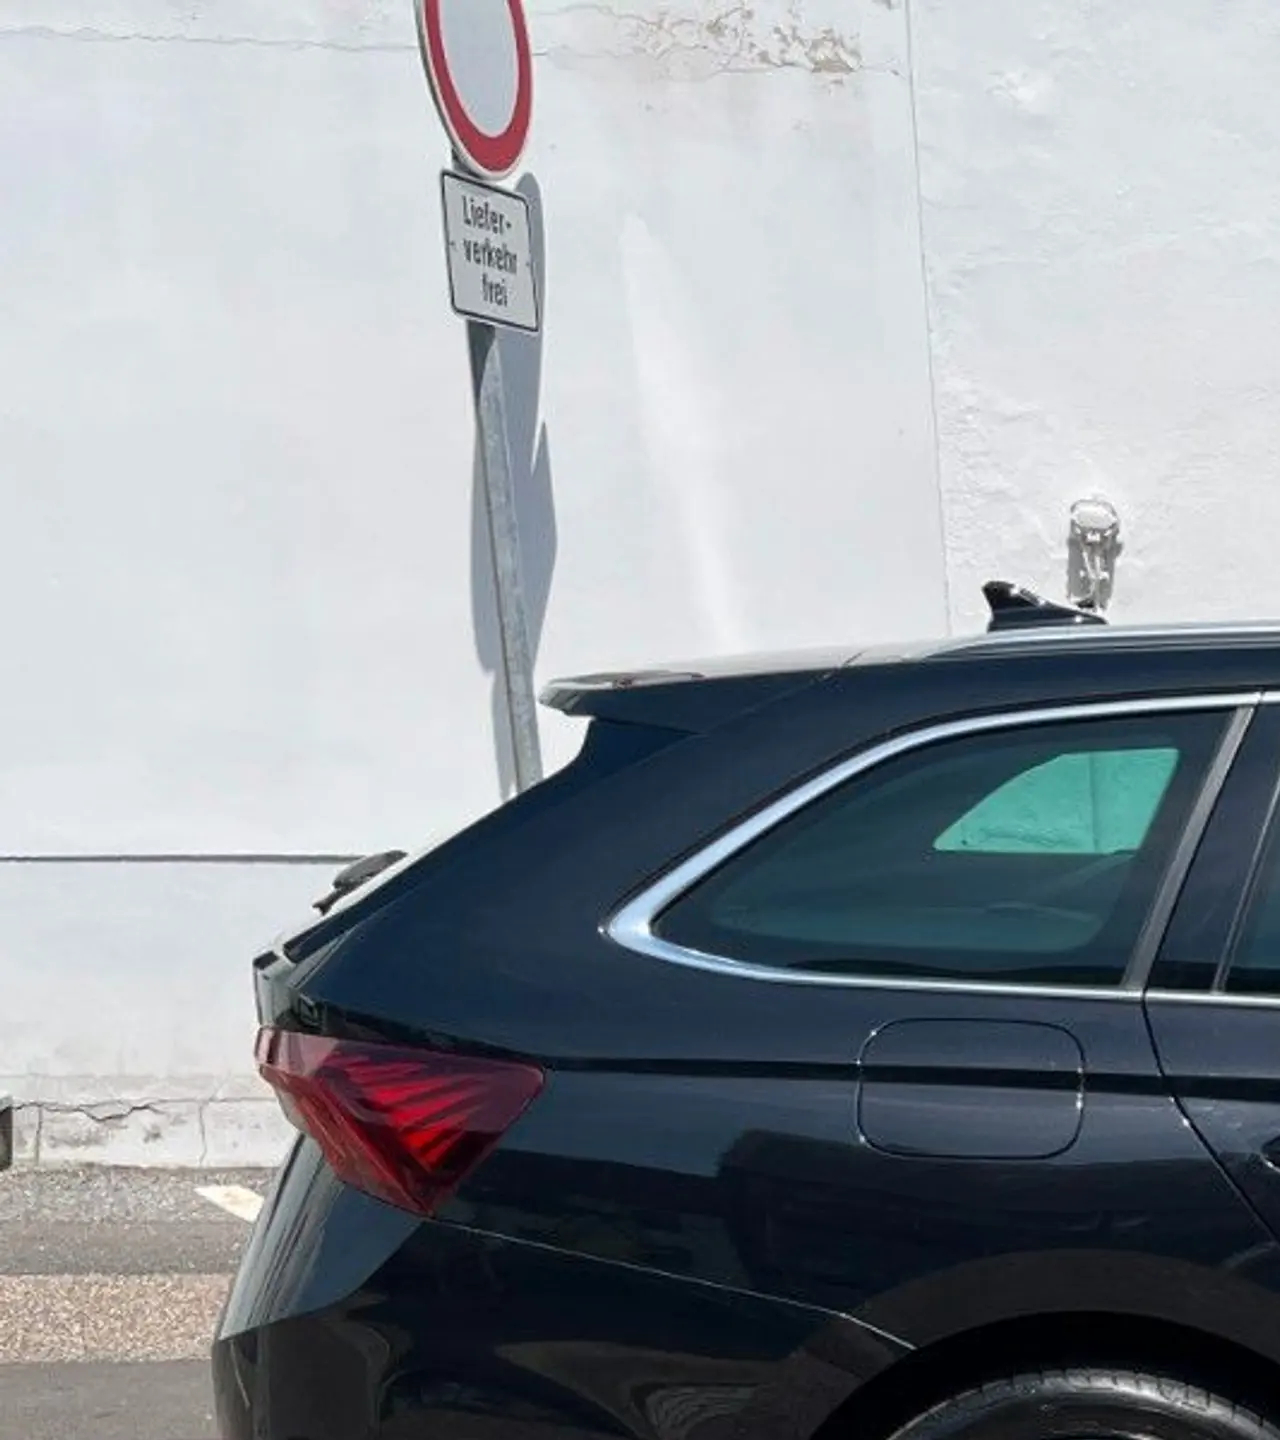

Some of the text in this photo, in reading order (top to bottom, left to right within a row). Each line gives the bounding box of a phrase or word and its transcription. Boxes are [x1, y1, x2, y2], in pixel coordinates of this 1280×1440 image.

[462, 195, 511, 235] Liefer-
[463, 238, 517, 274] verkehr
[482, 272, 508, 308] frei
